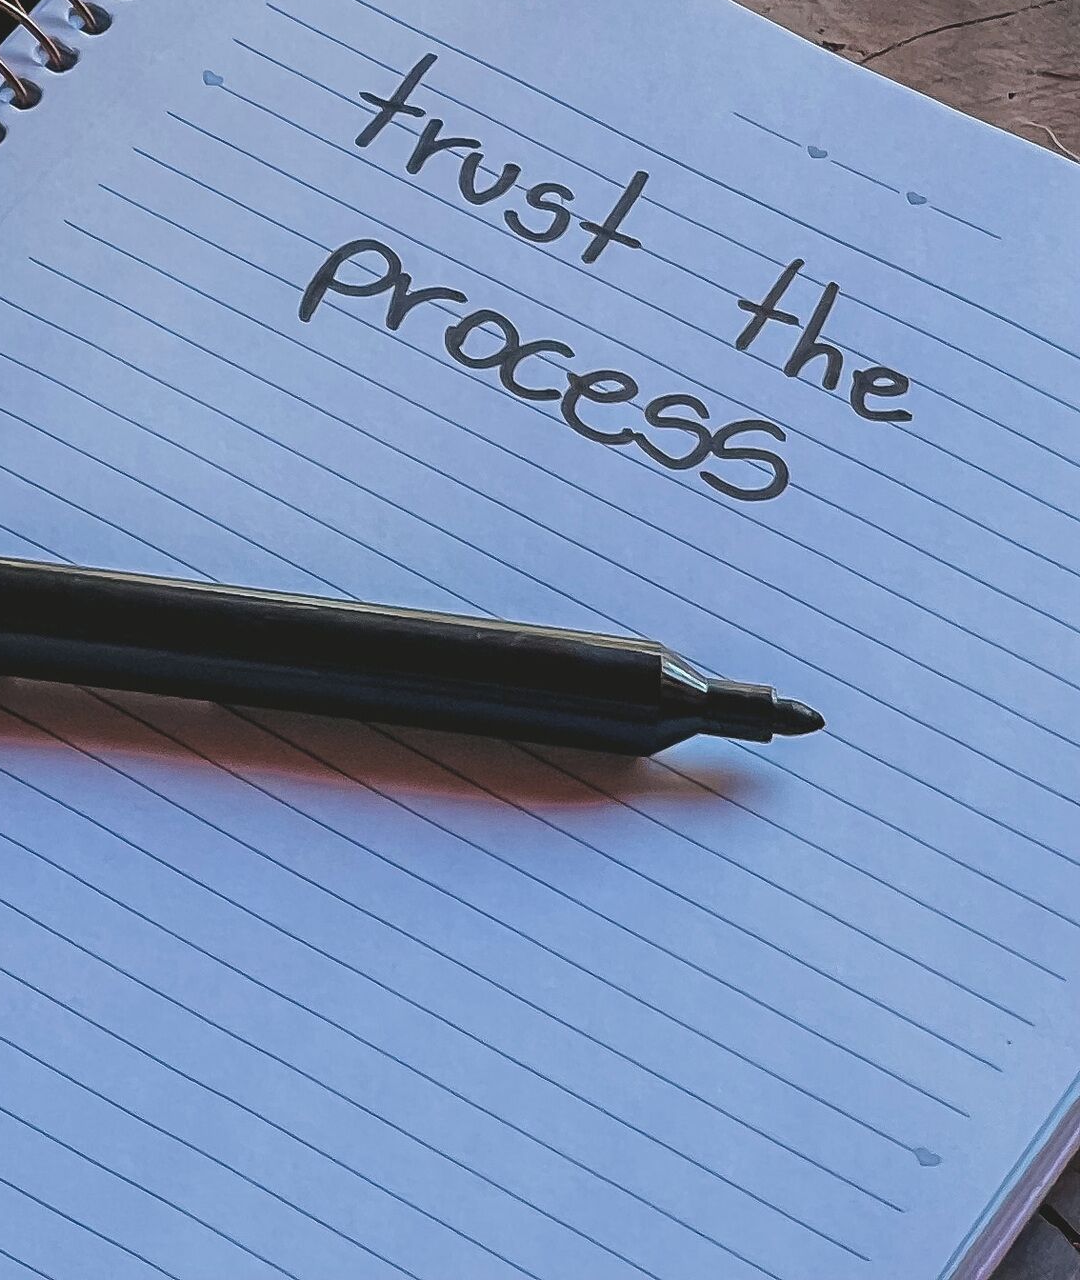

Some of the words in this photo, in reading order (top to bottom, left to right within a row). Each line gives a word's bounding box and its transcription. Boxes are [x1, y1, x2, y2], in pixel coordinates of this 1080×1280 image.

[298, 238, 790, 502] process
[354, 52, 650, 264] trust
[735, 258, 913, 422] the
